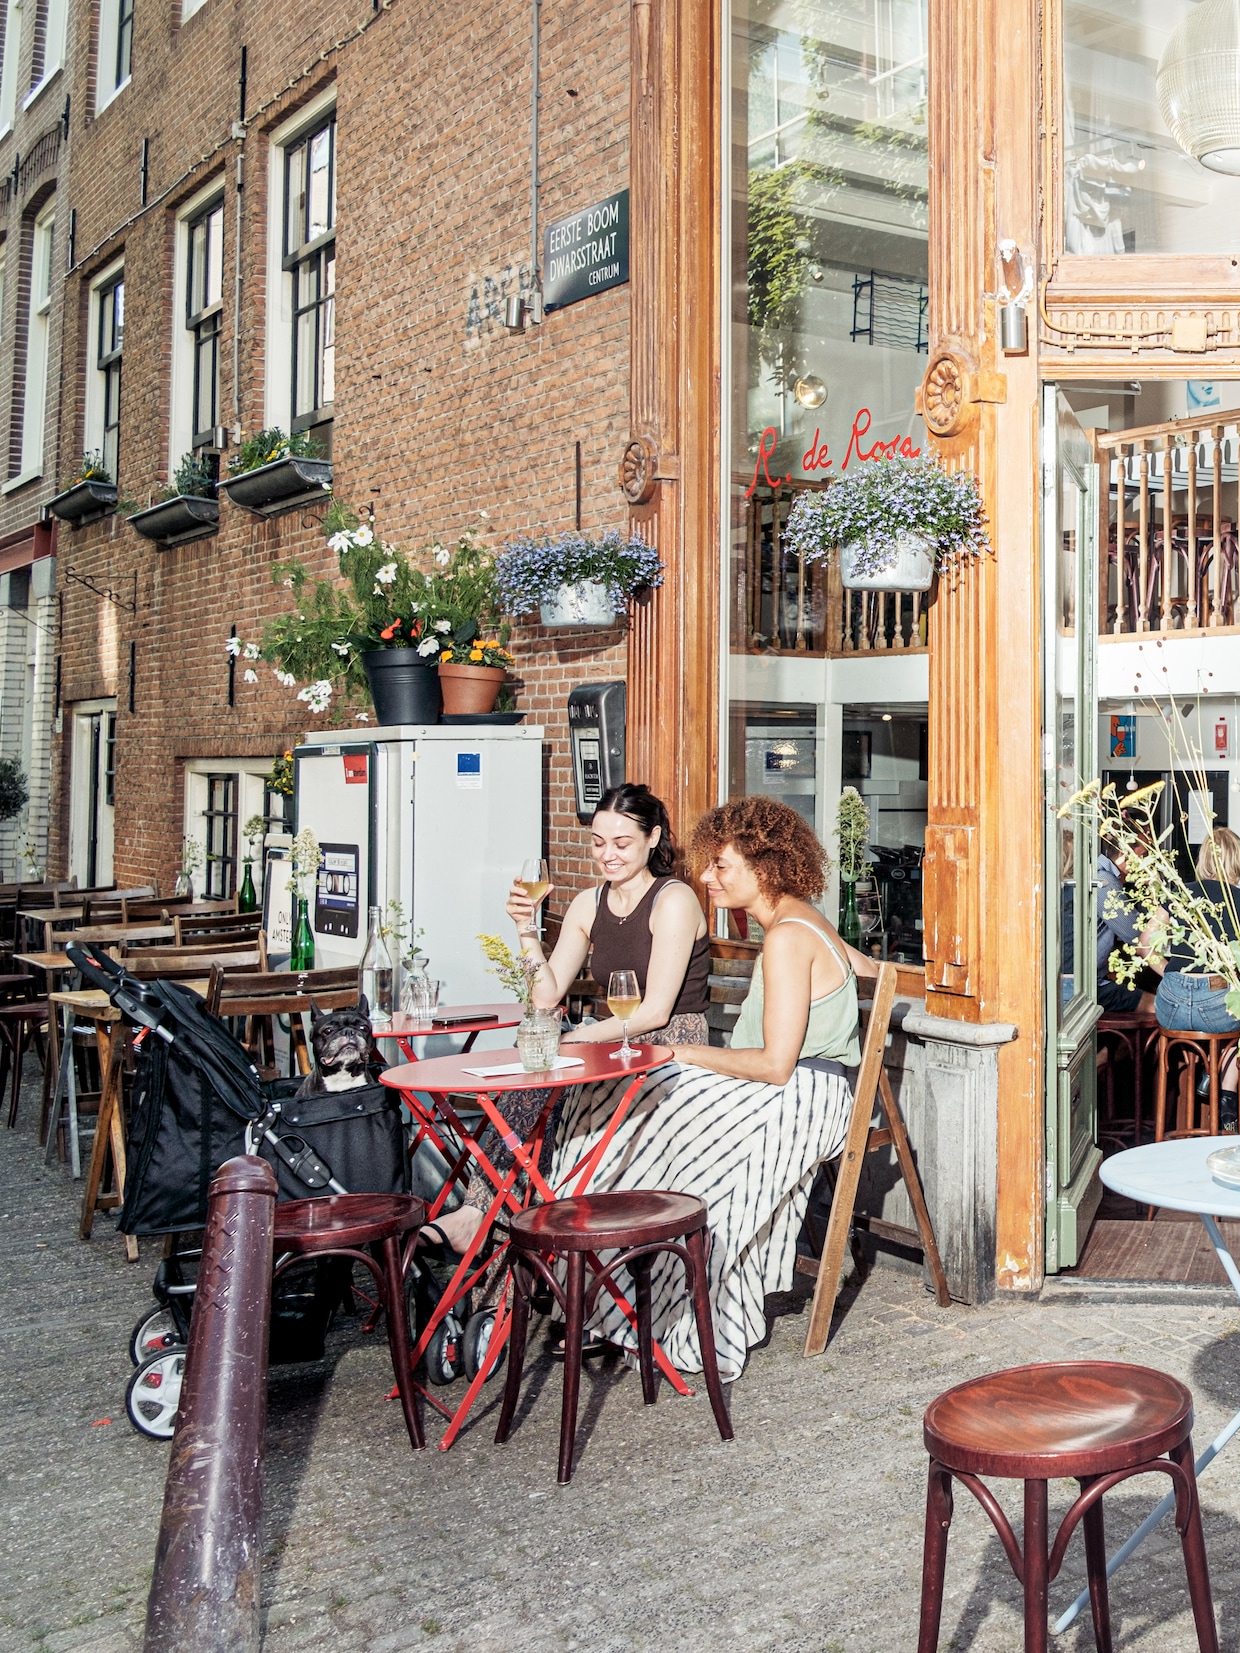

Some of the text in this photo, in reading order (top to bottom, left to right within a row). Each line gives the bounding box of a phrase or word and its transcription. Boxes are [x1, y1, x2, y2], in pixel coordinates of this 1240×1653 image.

[550, 201, 619, 253] EERSTE BOOM
[550, 232, 617, 282] DWARSSTRAAT
[588, 262, 620, 286] CENTRUM
[745, 408, 921, 498] R. de Rosa
